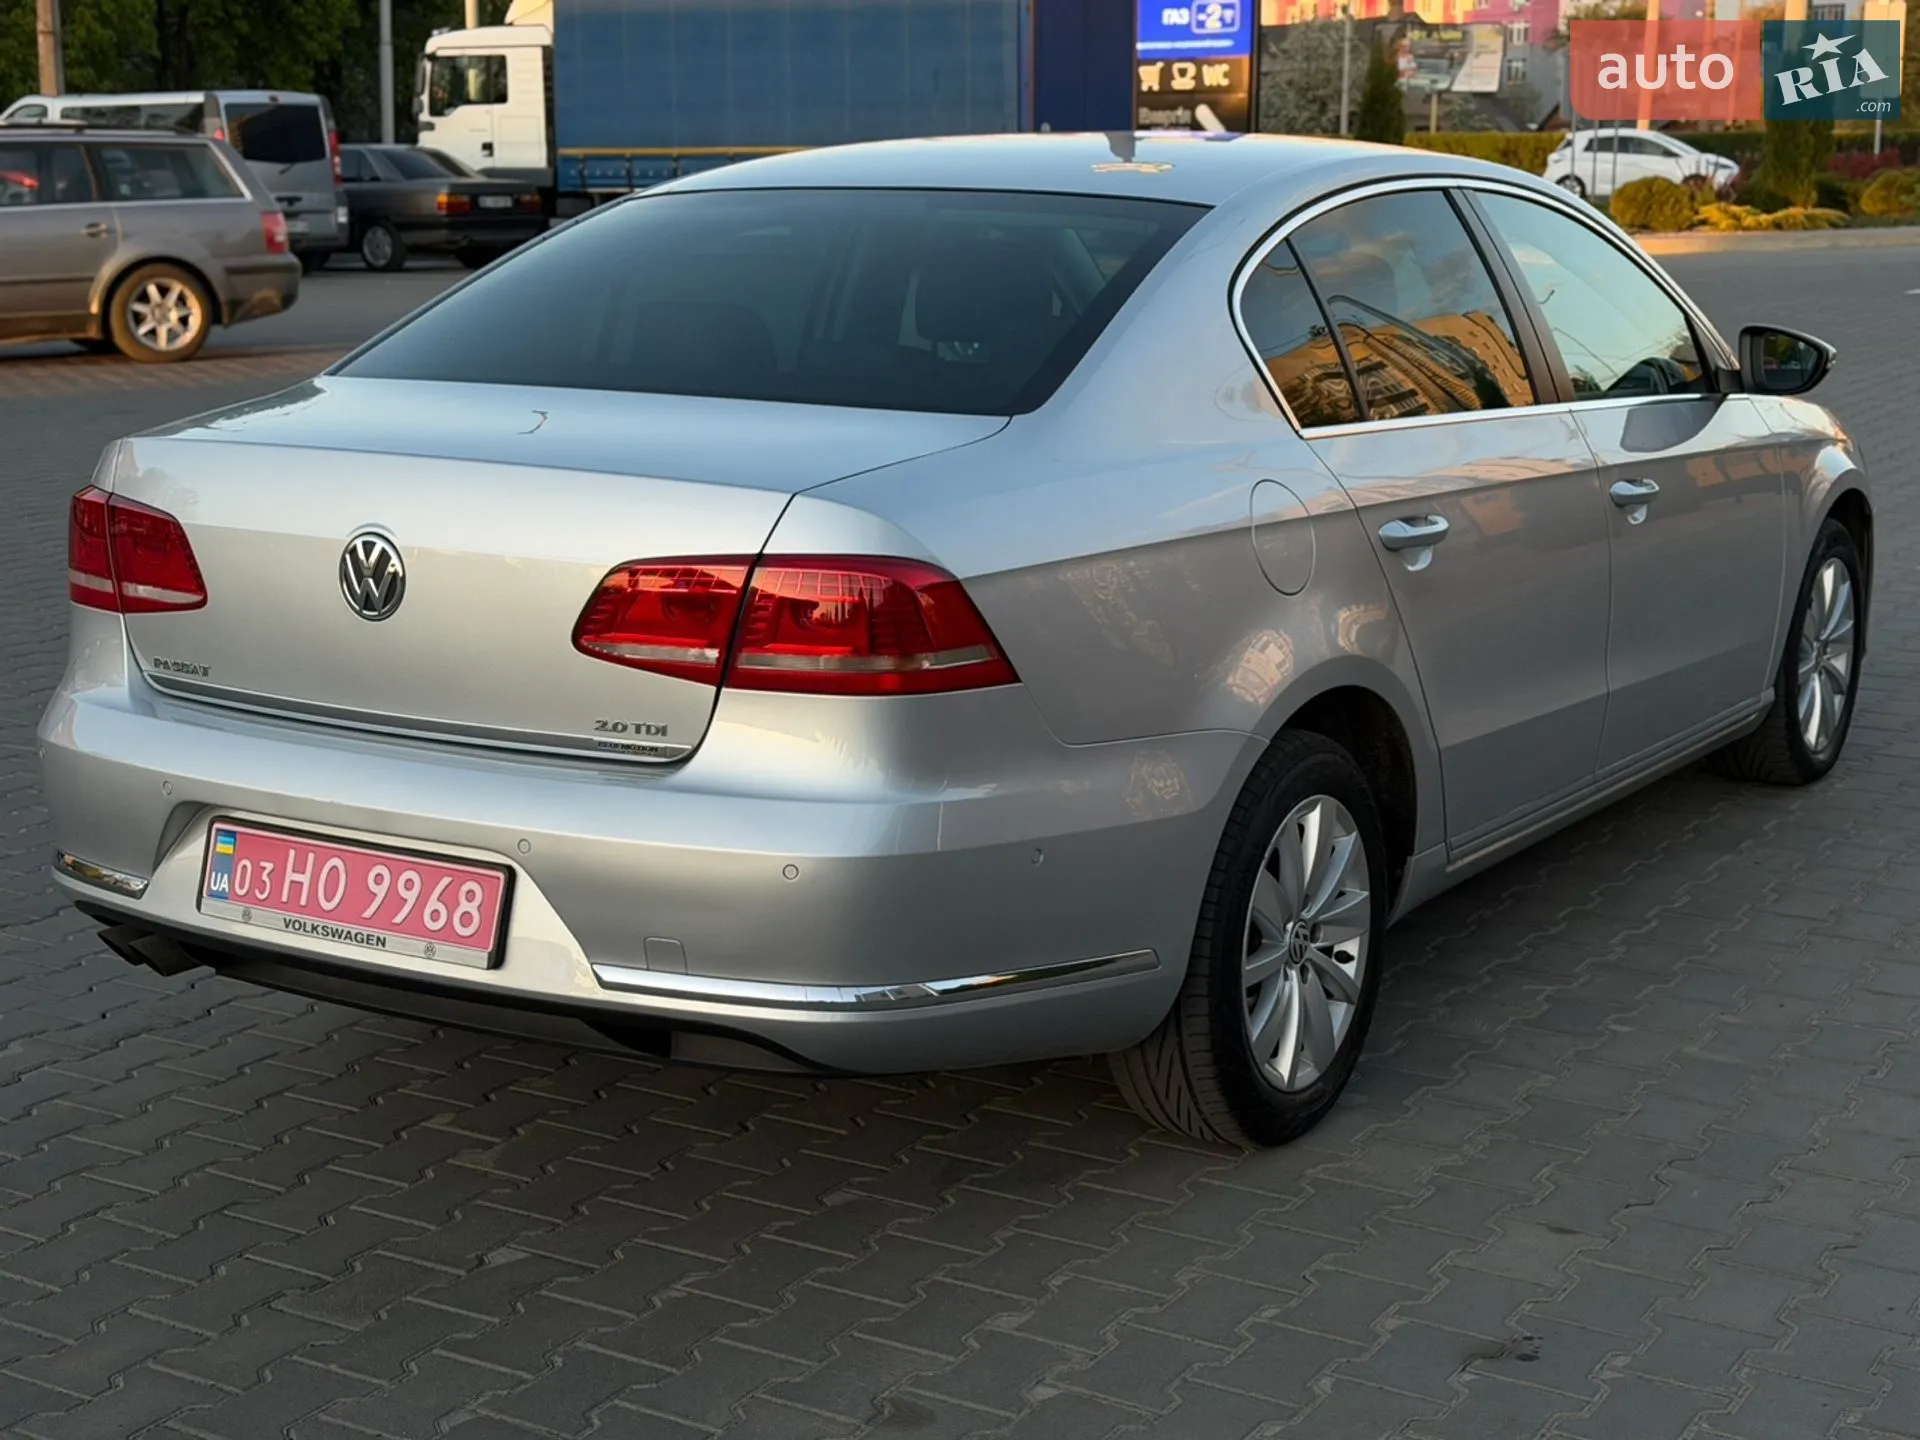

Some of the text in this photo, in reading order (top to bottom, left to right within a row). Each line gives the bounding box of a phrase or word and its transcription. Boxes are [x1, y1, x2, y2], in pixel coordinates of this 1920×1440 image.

[1201, 63, 1231, 87] WC
[153, 657, 211, 677] PASSAT
[631, 722, 668, 737] TDI
[210, 870, 230, 892] UA
[234, 858, 274, 901] 03
[361, 863, 485, 938] 9968
[283, 917, 387, 948] VOLKSWAGEN
